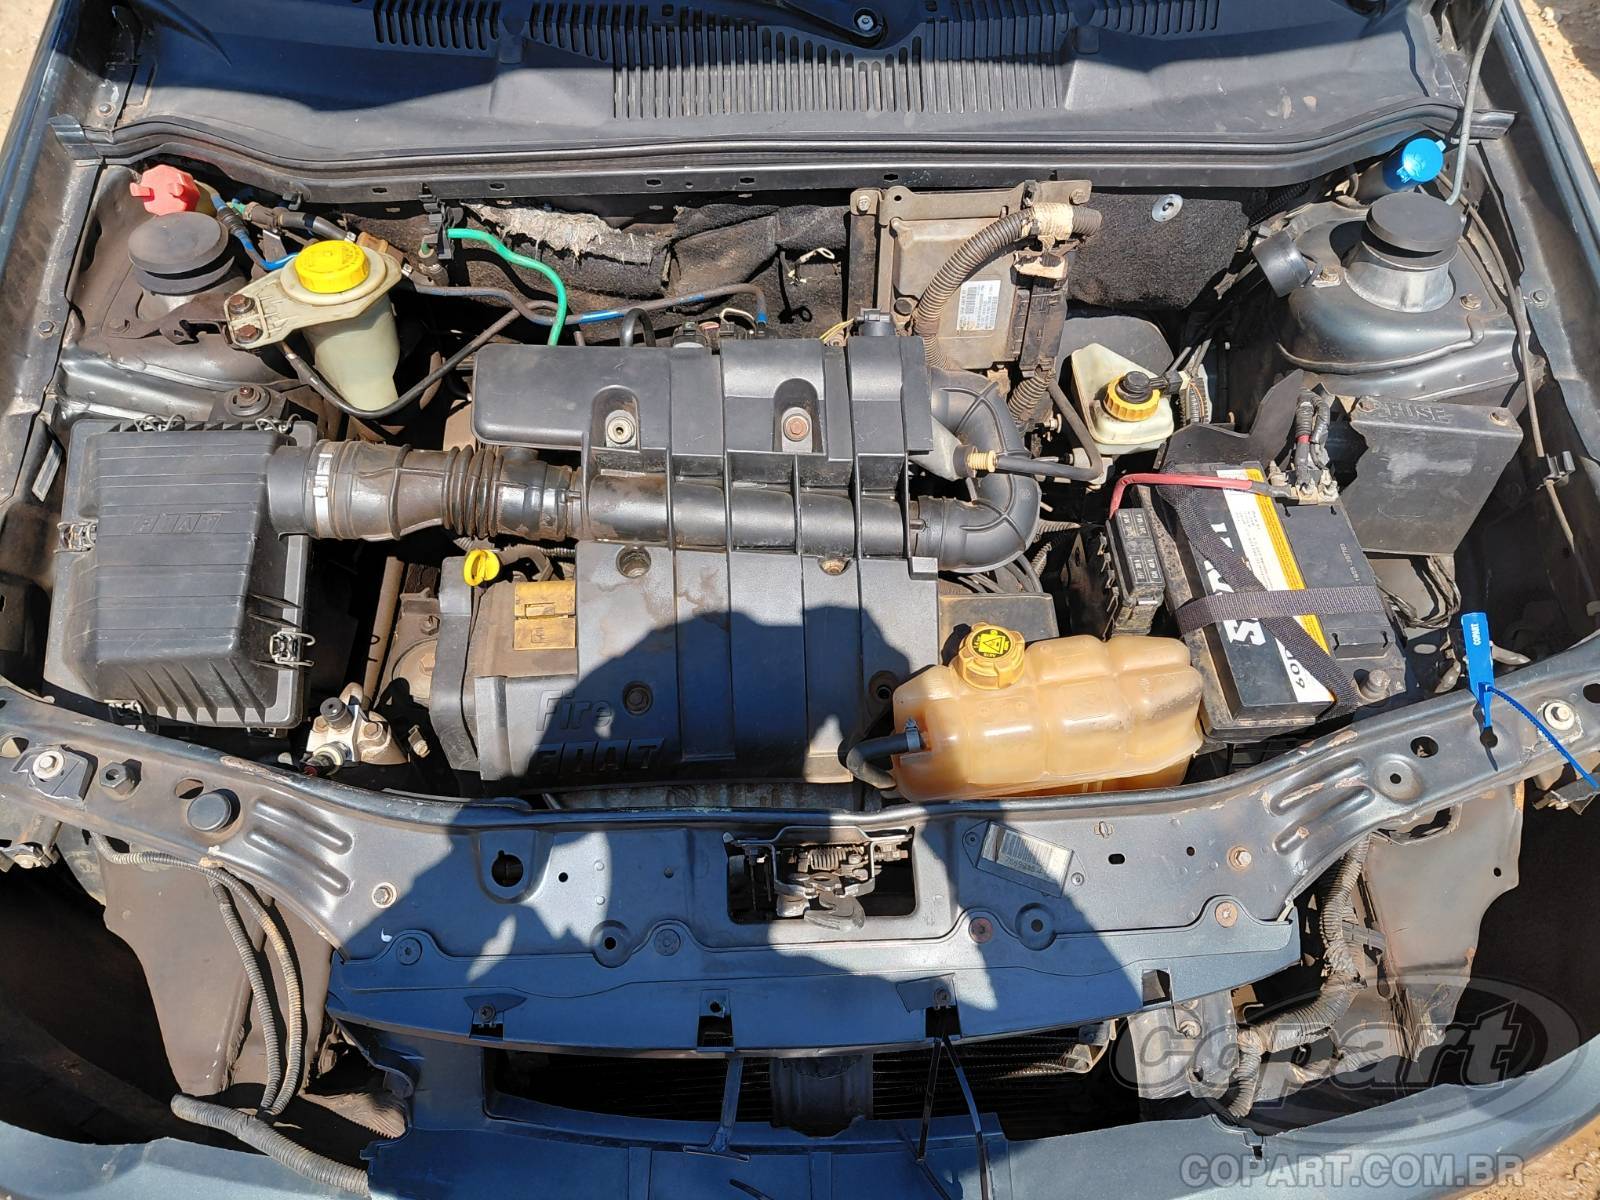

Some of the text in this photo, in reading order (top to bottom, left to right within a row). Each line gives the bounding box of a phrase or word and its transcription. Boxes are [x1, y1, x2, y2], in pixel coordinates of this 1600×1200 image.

[1470, 623, 1481, 646] COPART
[536, 689, 612, 731] Fire
[528, 740, 664, 776] FIAT
